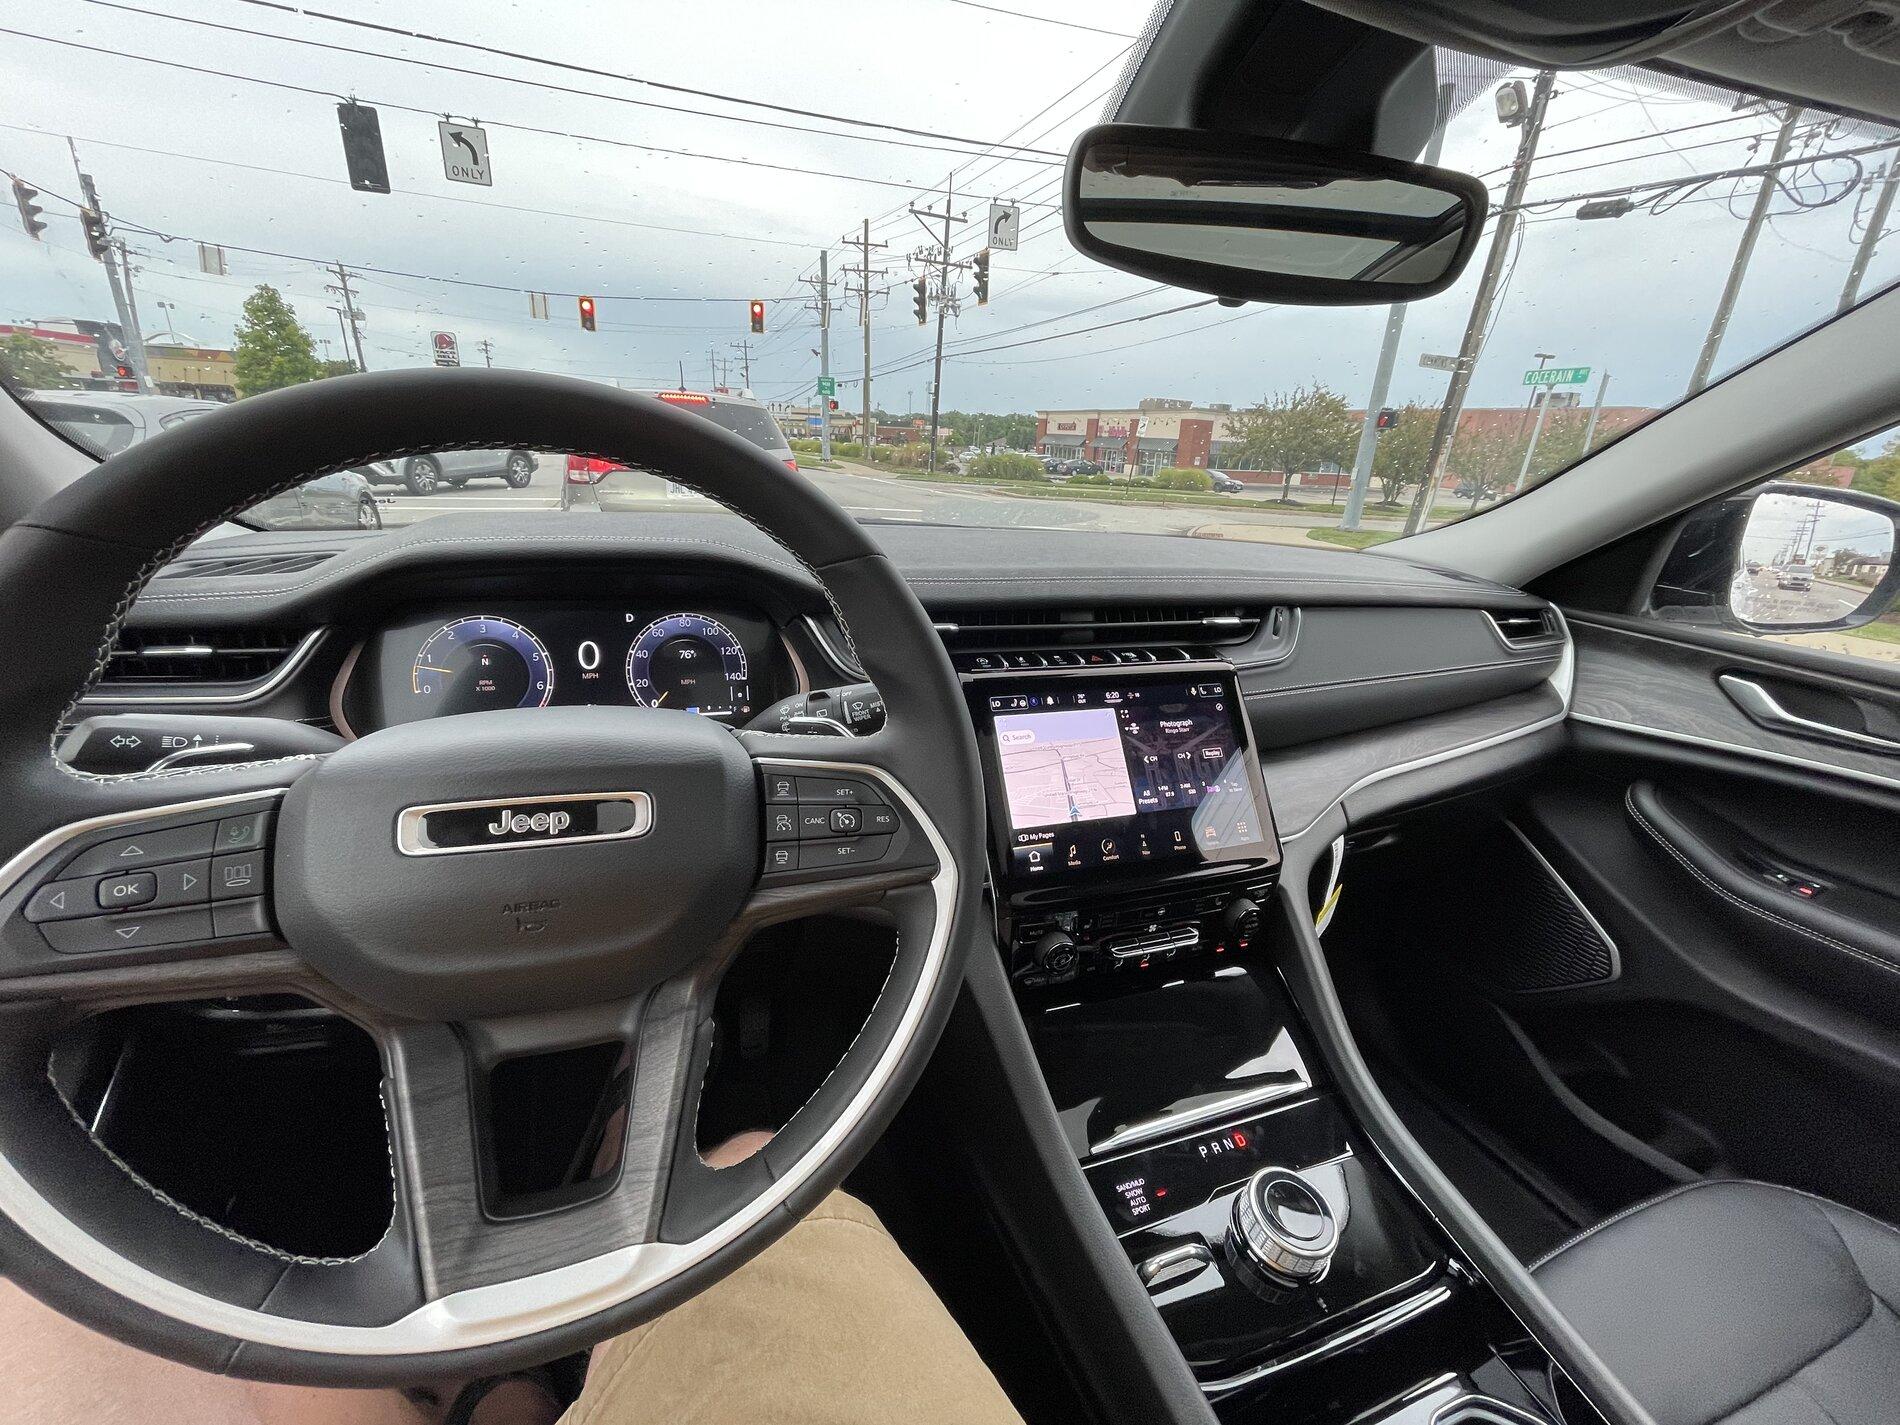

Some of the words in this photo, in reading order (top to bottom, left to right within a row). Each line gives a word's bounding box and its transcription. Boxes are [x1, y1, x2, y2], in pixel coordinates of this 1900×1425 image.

[452, 165, 485, 180] ONLY
[992, 236, 1014, 247] ONLY
[626, 614, 634, 623] D
[679, 618, 691, 627] 80
[480, 624, 487, 634] 3
[652, 628, 665, 638] 60
[702, 627, 719, 636] 100
[448, 631, 455, 640] 2
[511, 630, 519, 640] 4
[578, 640, 600, 670] 0
[635, 650, 648, 659] 40
[720, 647, 737, 655] 120
[427, 653, 432, 663] 1
[481, 657, 489, 666] N
[532, 652, 539, 662] 5
[582, 672, 599, 680] MPH
[725, 672, 742, 681] 140
[536, 681, 544, 690] 6
[636, 679, 648, 688] 20
[424, 685, 431, 694] 0
[651, 699, 658, 708] 0
[852, 709, 870, 717] FRONT
[1160, 719, 1193, 728] Photograph
[836, 788, 854, 796] SET+
[1138, 797, 1159, 805] Presets
[488, 809, 570, 835] Jeep
[113, 883, 138, 897] OK
[1198, 1146, 1208, 1159] P
[1211, 1142, 1222, 1155] R
[1223, 1138, 1234, 1151] N
[1234, 1133, 1246, 1148] D
[1125, 1188, 1144, 1199] SNOW
[1130, 1196, 1147, 1207] AUTO
[1132, 1204, 1151, 1216] SPORT
